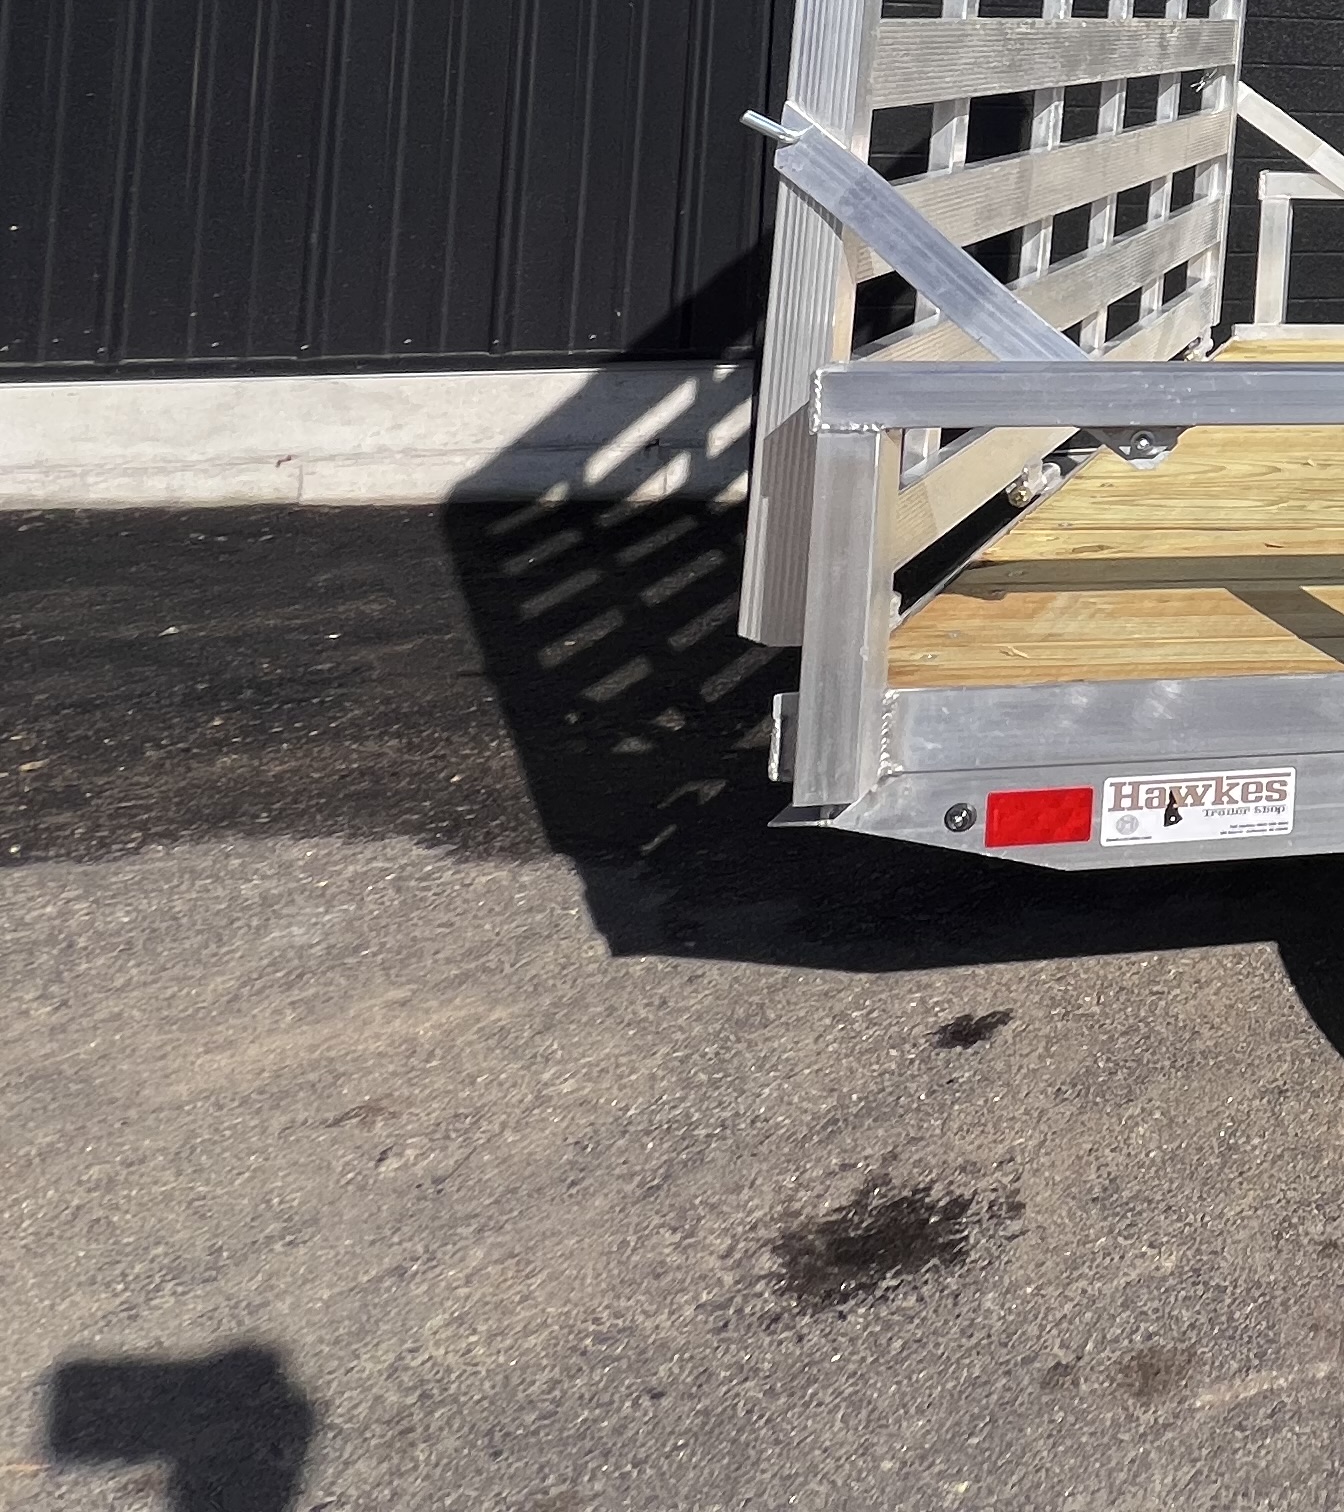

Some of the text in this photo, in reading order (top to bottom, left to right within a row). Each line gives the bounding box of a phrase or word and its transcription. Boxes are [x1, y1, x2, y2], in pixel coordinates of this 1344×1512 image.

[1107, 776, 1288, 812] Hawkes
[1202, 804, 1286, 818] Trailer Shop
